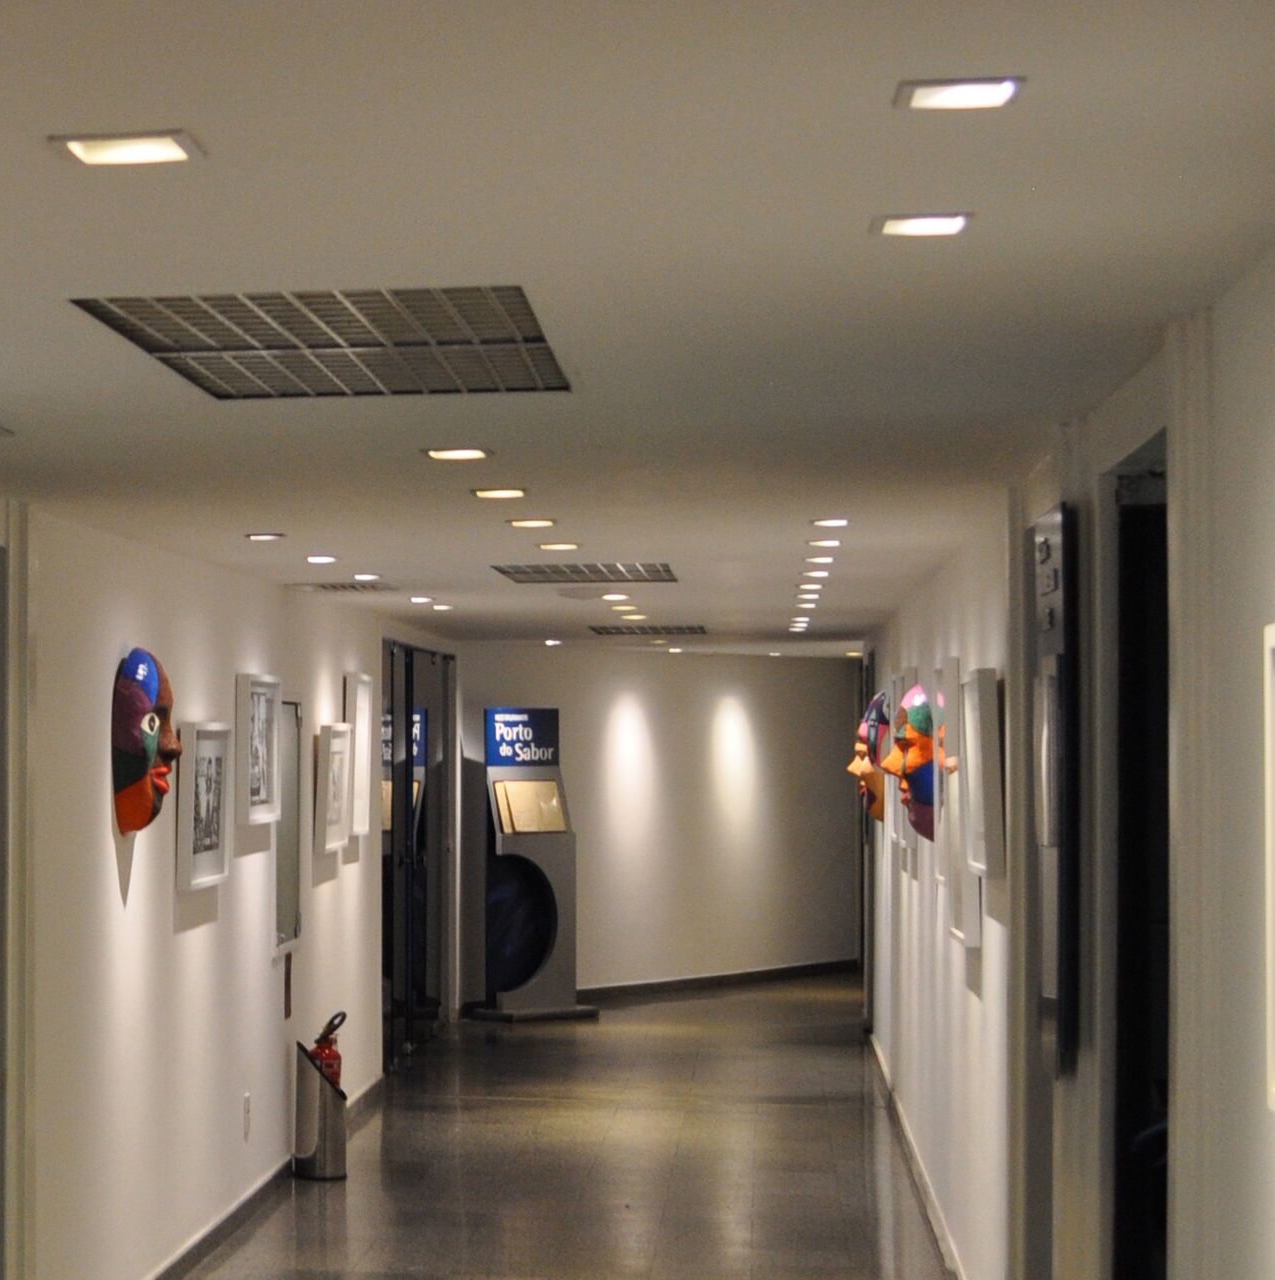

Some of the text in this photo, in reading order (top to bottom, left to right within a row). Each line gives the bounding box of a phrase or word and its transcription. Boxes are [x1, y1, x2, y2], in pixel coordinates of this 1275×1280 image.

[494, 722, 533, 741] Porto
[499, 742, 554, 761] do Sabor
